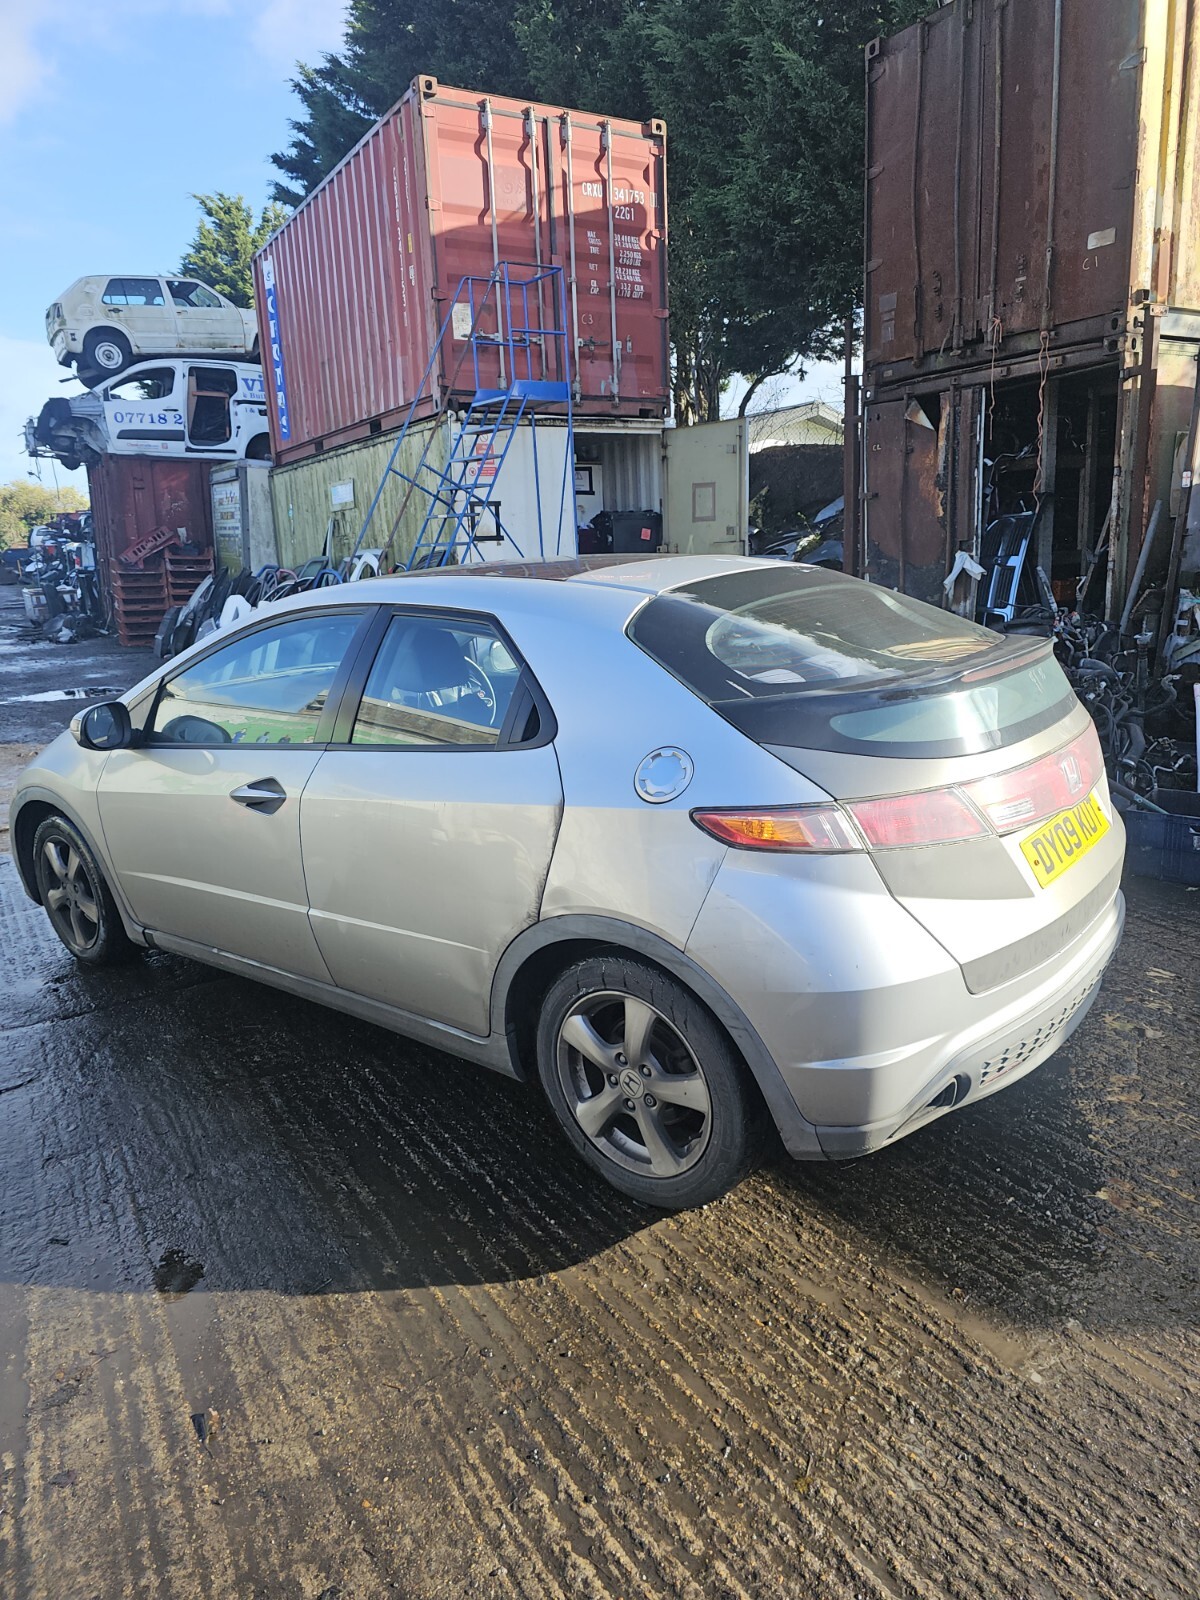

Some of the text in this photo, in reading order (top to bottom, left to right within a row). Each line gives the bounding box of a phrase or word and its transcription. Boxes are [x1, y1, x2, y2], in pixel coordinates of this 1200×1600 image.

[582, 182, 602, 197] CRXU
[613, 187, 645, 205] 341753
[615, 205, 634, 221] 22G1
[113, 411, 184, 425] 07718 2
[1031, 816, 1083, 875] DY09
